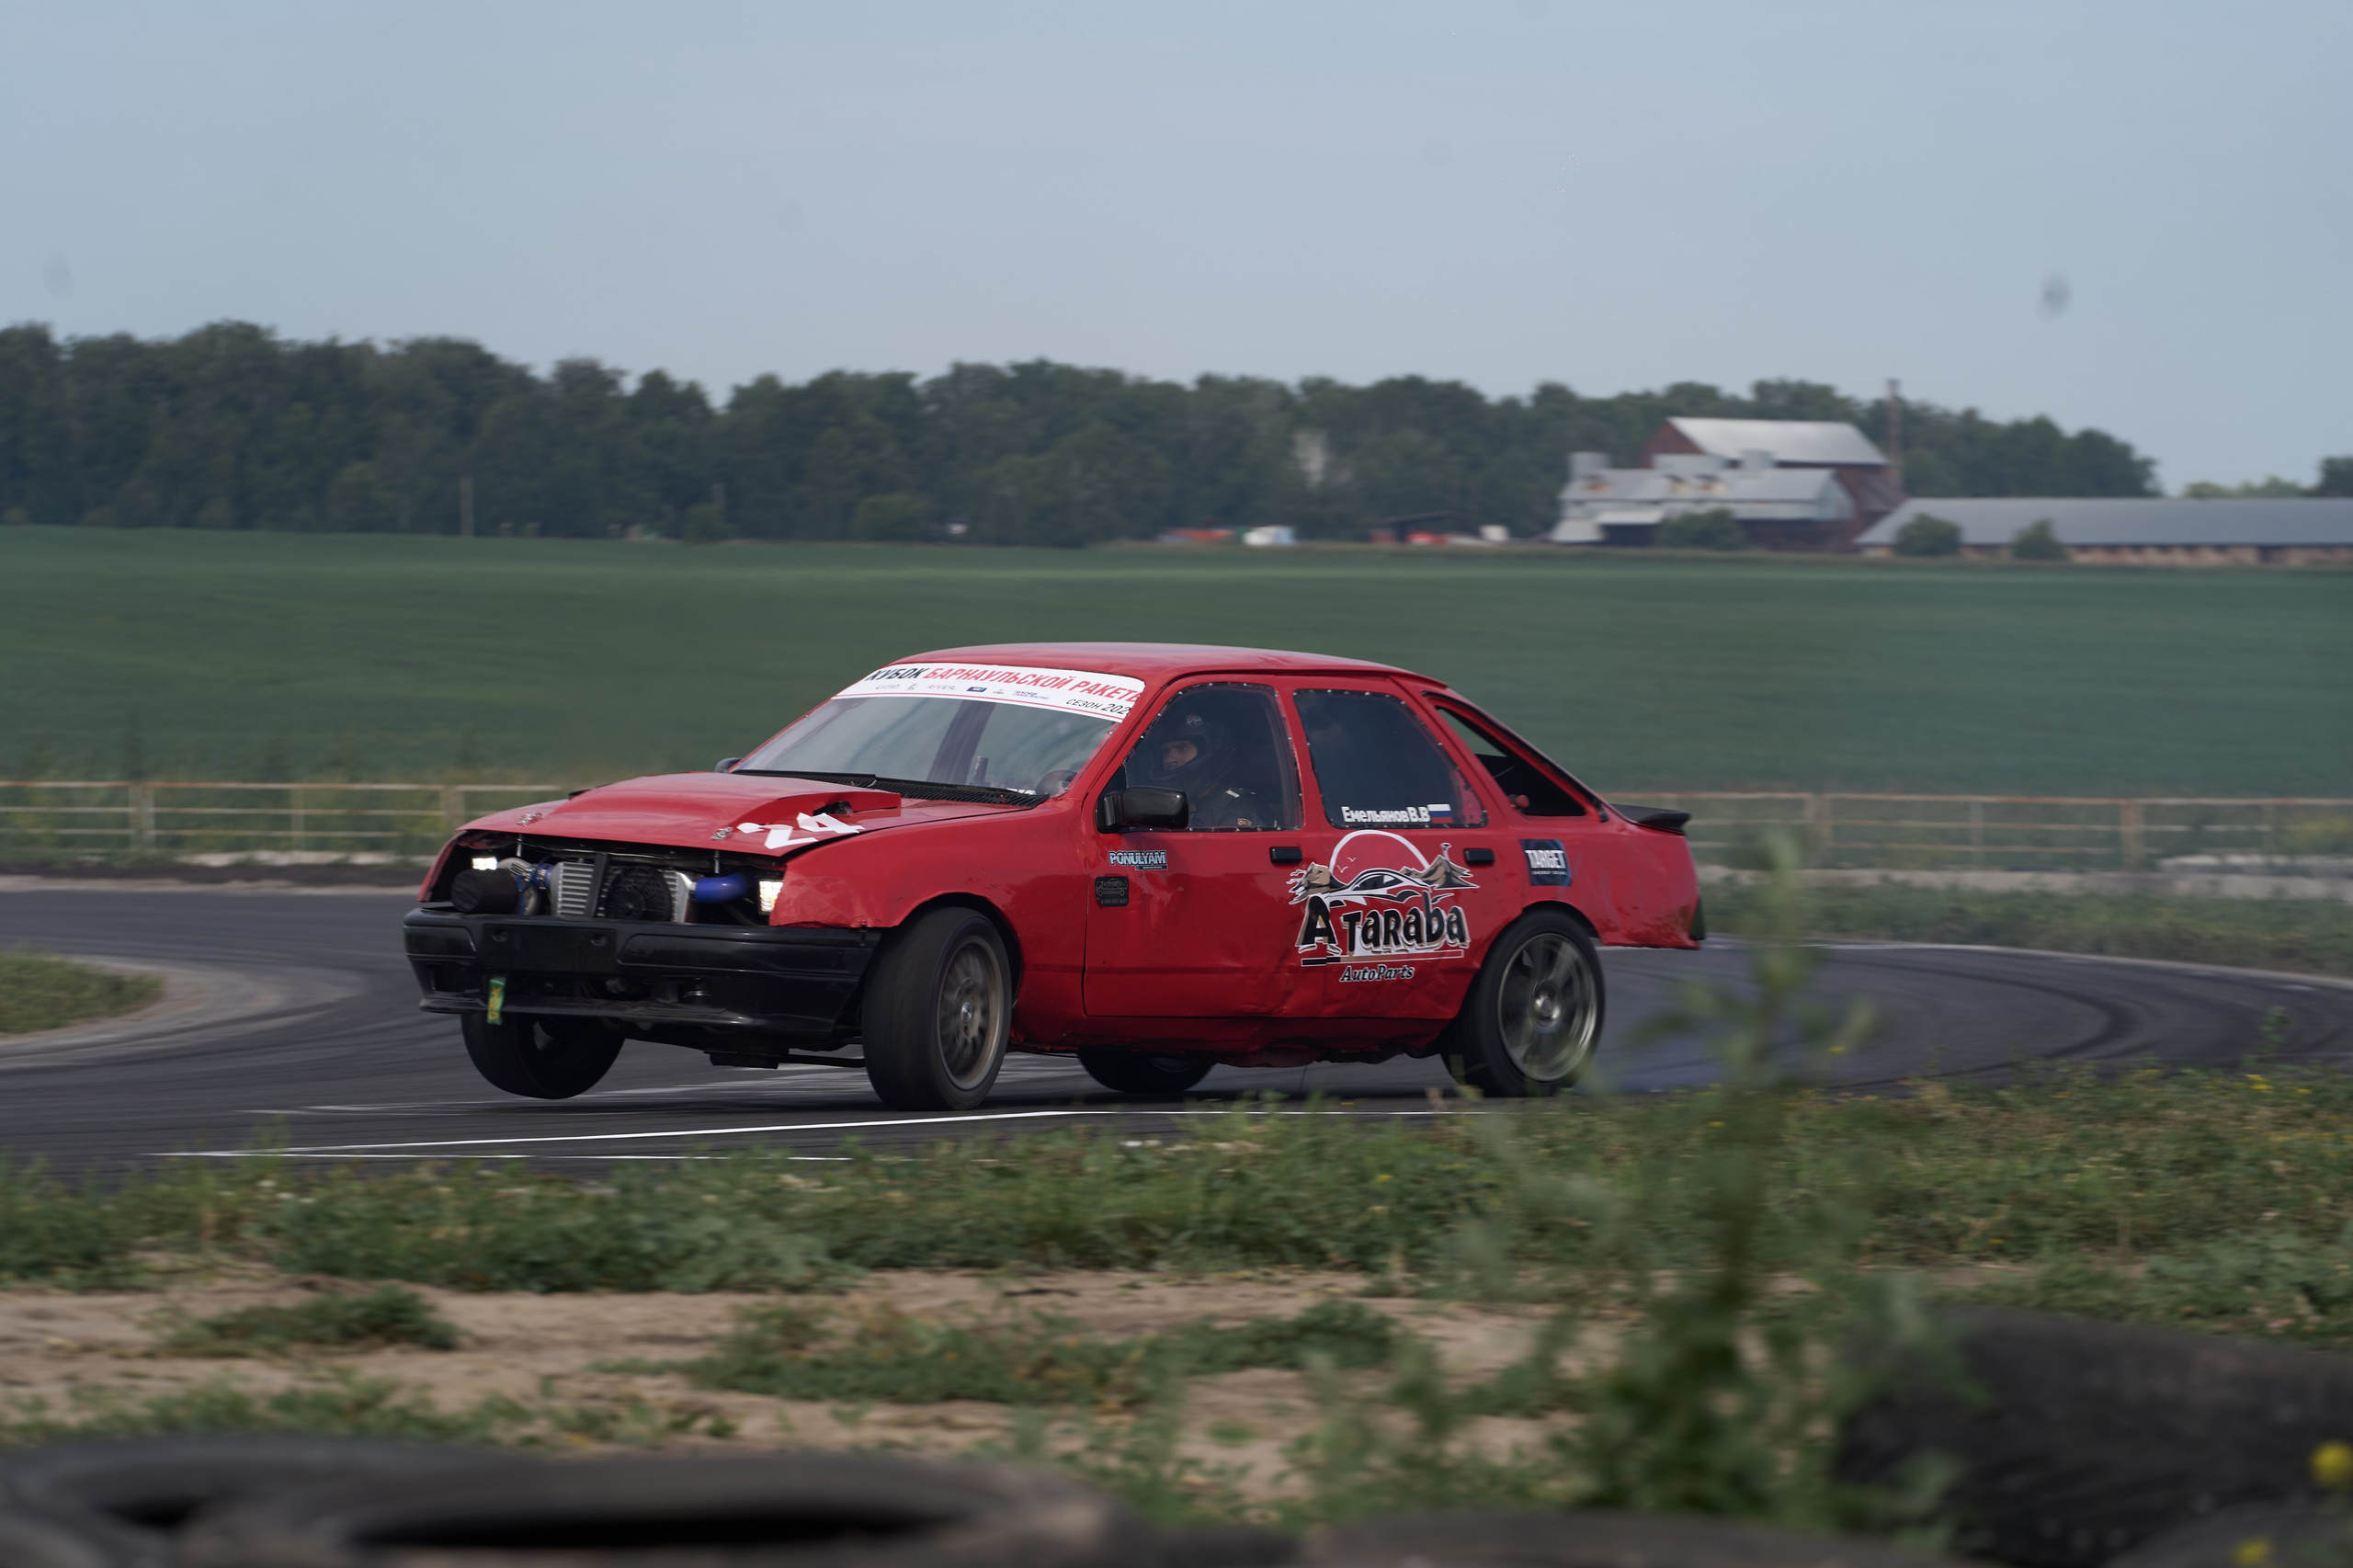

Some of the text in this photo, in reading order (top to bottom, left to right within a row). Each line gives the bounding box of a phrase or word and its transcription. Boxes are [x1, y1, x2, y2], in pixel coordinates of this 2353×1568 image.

[922, 668, 1077, 689] БАРНАУЛЬСКОЙ
[1066, 699, 1131, 715] СЕЗОН 202
[1108, 850, 1166, 865] PONULYAM
[1339, 965, 1415, 982] AutoParts
